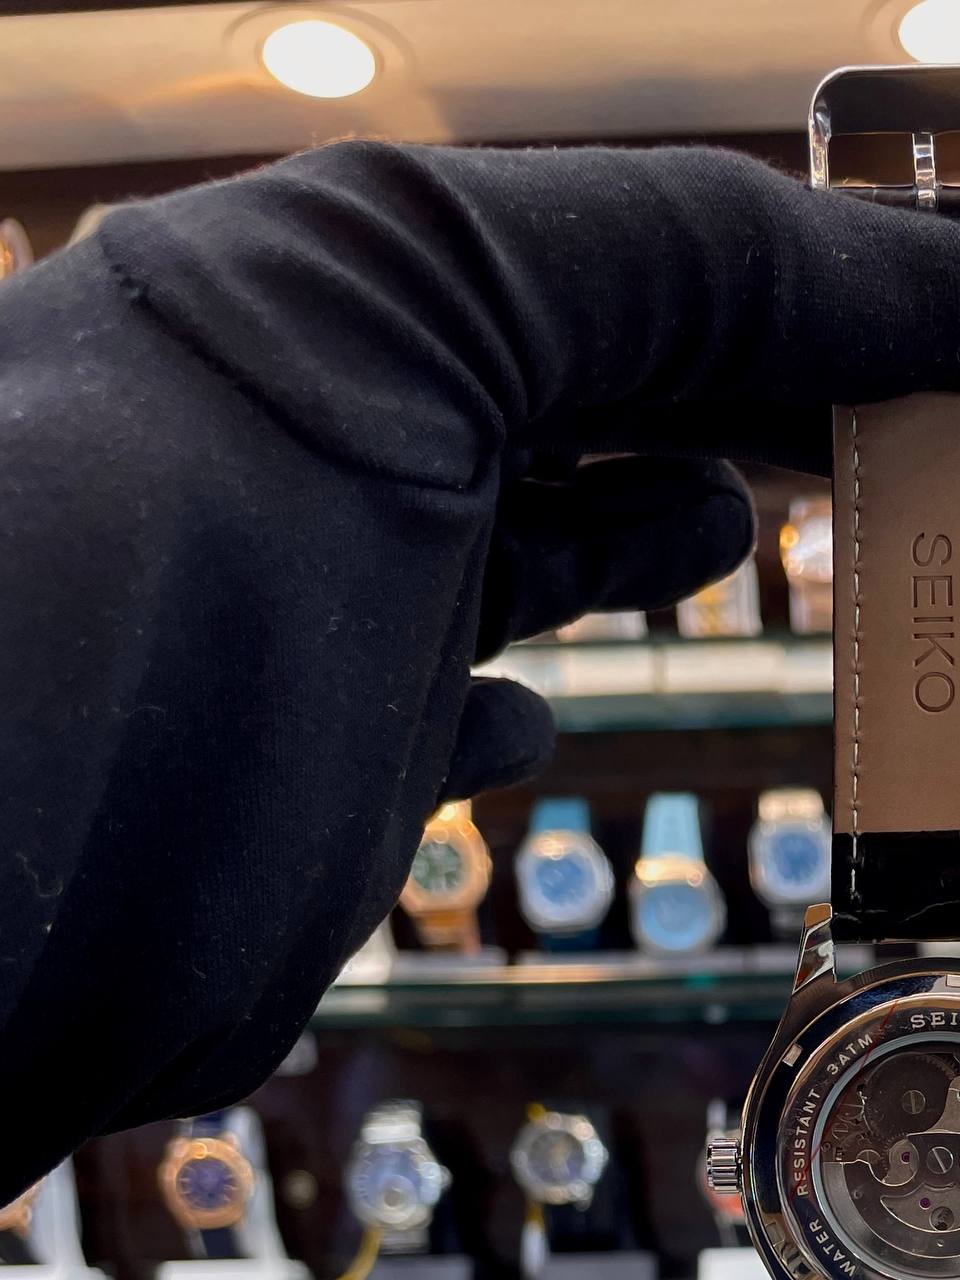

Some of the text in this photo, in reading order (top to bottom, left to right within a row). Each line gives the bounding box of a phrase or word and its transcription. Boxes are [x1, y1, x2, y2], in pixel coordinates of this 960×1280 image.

[911, 532, 955, 713] SEIKO
[797, 1033, 874, 1278] WATER RESISTANT 3ATM
